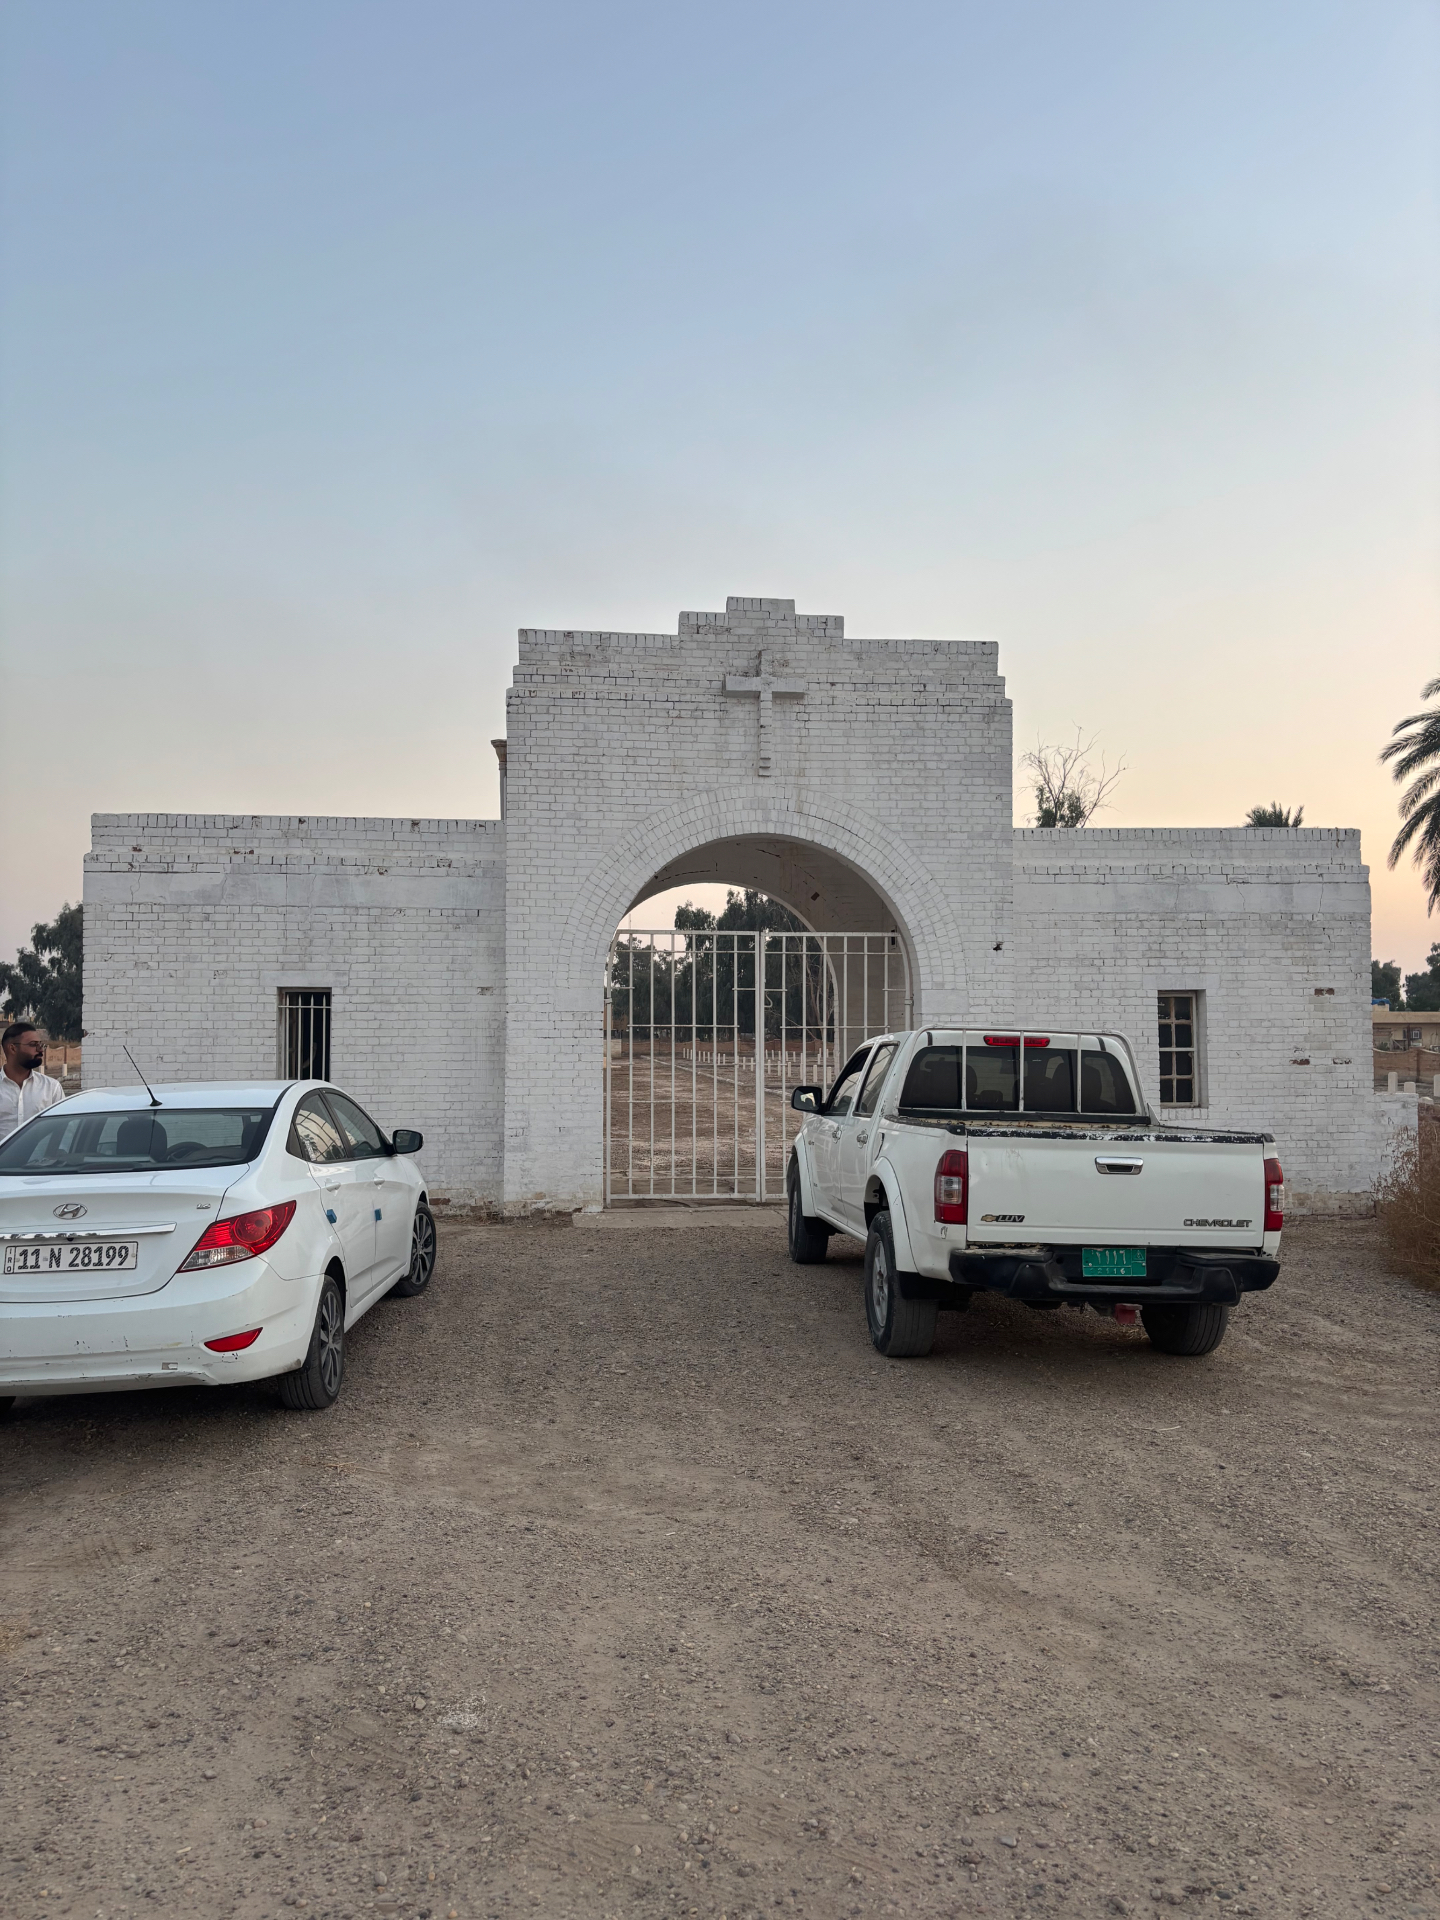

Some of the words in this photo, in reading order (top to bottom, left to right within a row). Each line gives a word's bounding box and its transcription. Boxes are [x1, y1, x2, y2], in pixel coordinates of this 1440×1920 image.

[1183, 1218, 1253, 1228] CHEVROLET
[18, 1248, 41, 1270] 11
[48, 1247, 62, 1269] N
[68, 1245, 130, 1268] 28199
